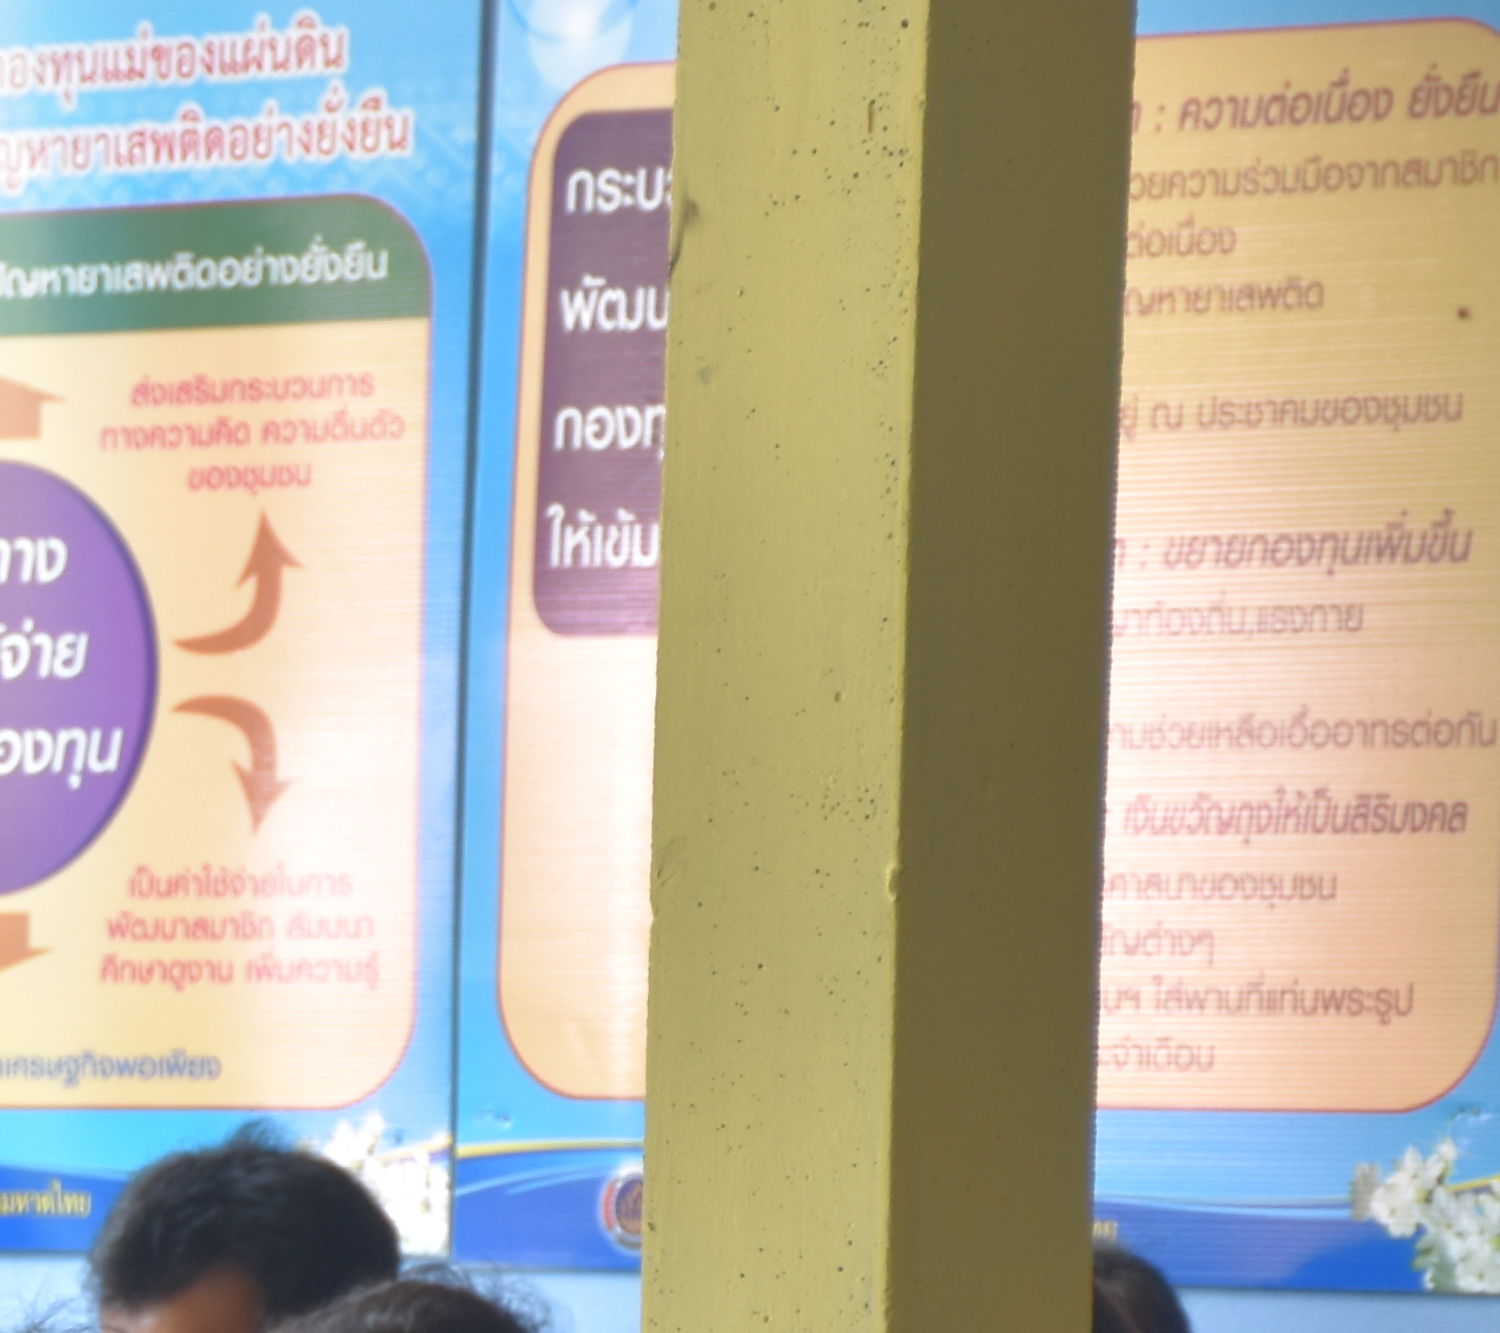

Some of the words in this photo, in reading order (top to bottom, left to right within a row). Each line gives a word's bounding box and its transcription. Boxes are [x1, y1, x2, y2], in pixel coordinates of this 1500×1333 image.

[1177, 66, 1395, 131] ความต่อเนื่อง
[187, 463, 313, 497] ของชุมชน
